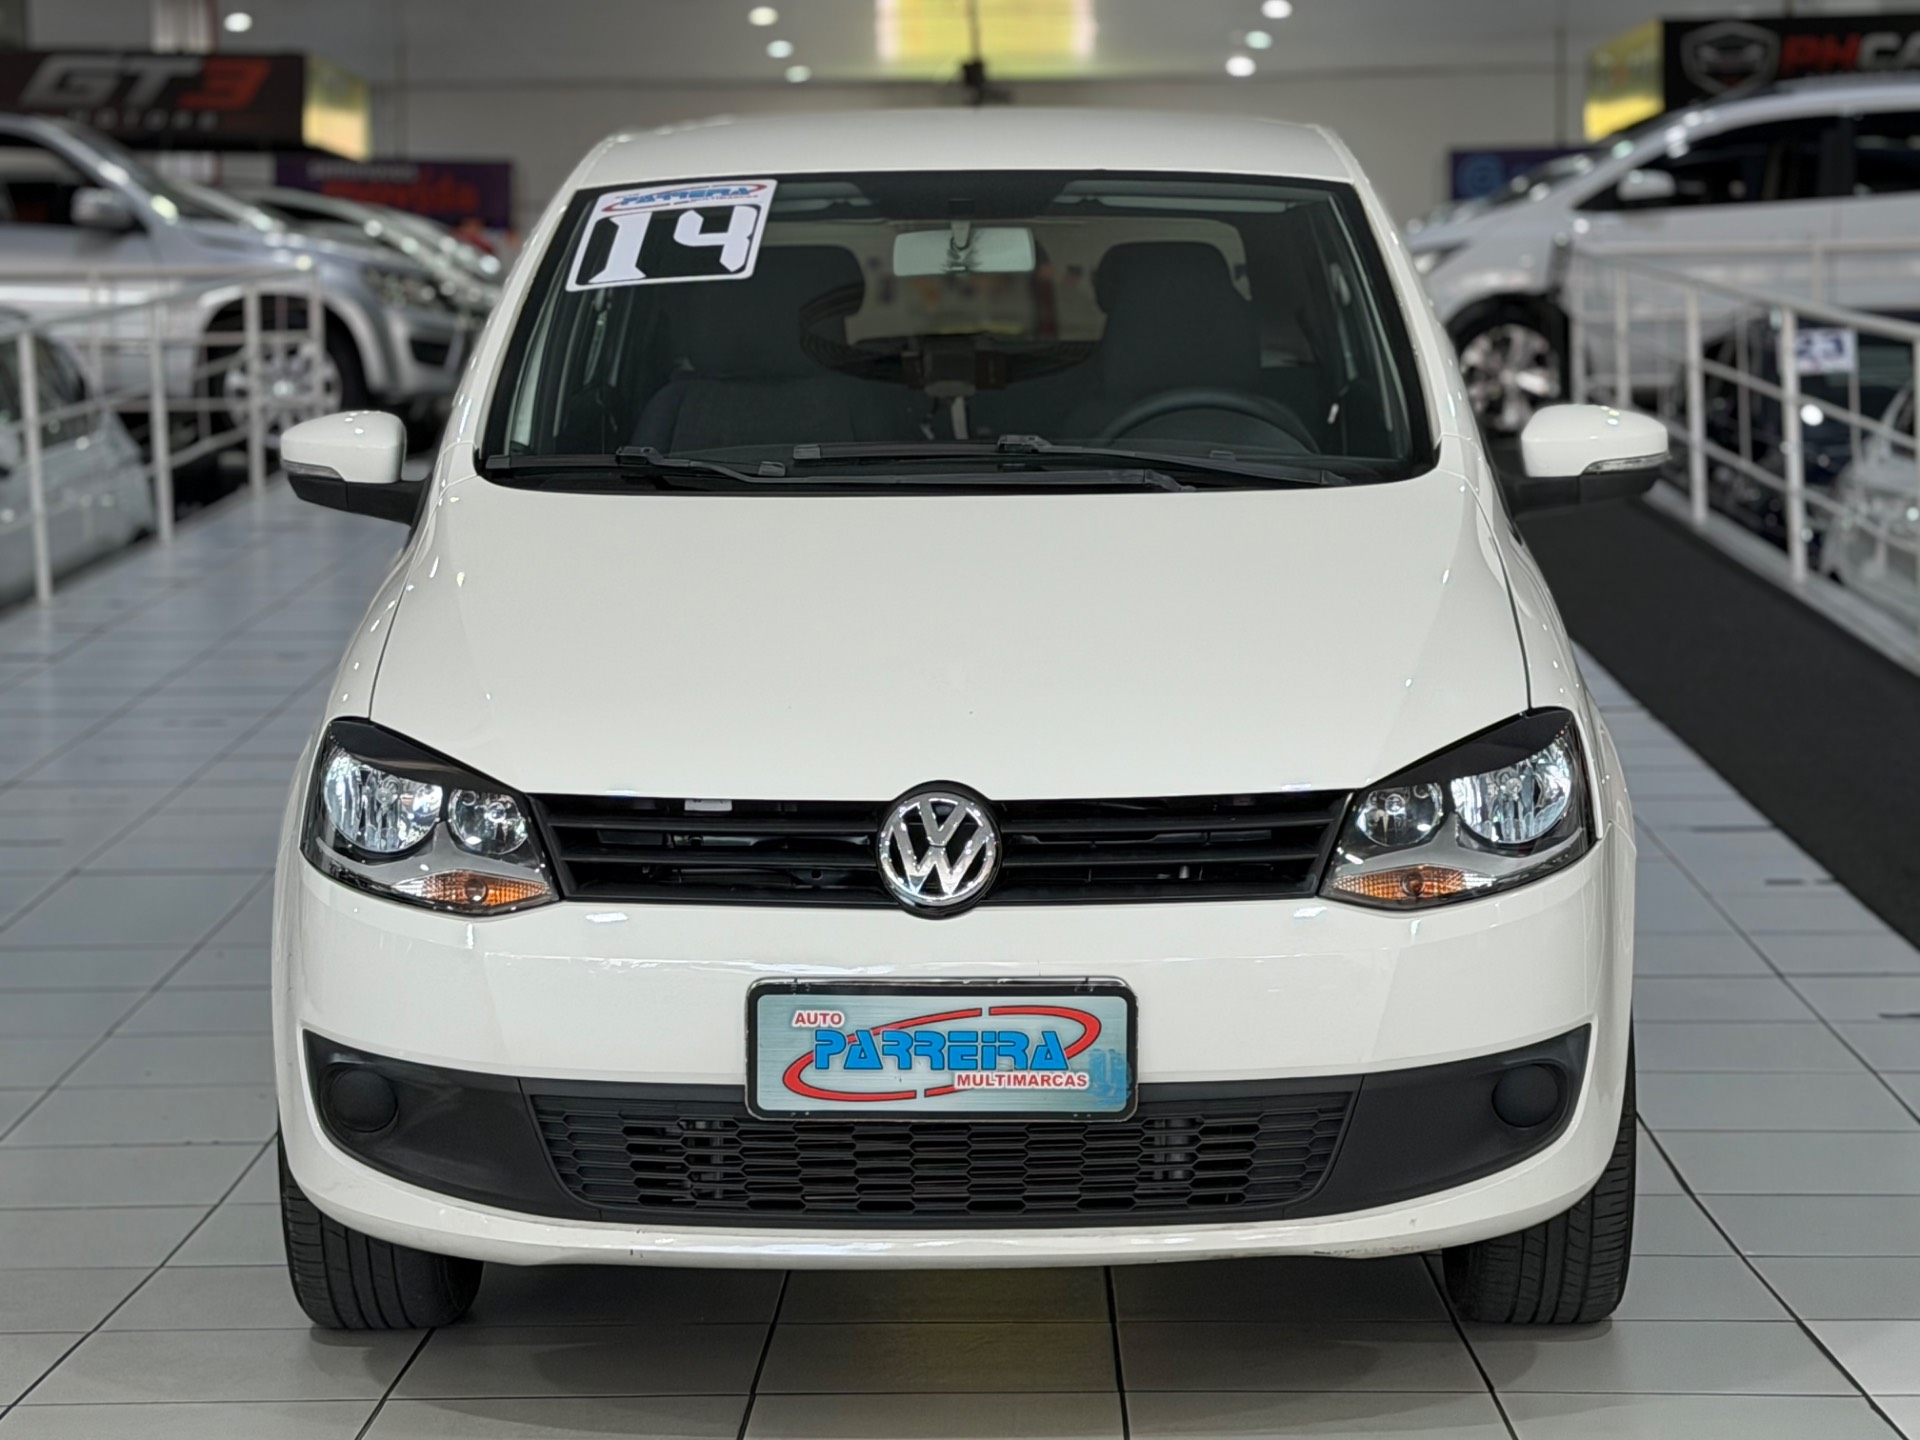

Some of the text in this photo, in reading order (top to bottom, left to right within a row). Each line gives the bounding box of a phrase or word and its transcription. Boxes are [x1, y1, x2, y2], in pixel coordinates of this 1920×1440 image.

[20, 54, 271, 108] GT3
[588, 206, 758, 284] 14
[793, 1011, 843, 1026] AUTO
[813, 1029, 1069, 1071] PARREIRA
[956, 1074, 1088, 1088] MULTIMARCAS
